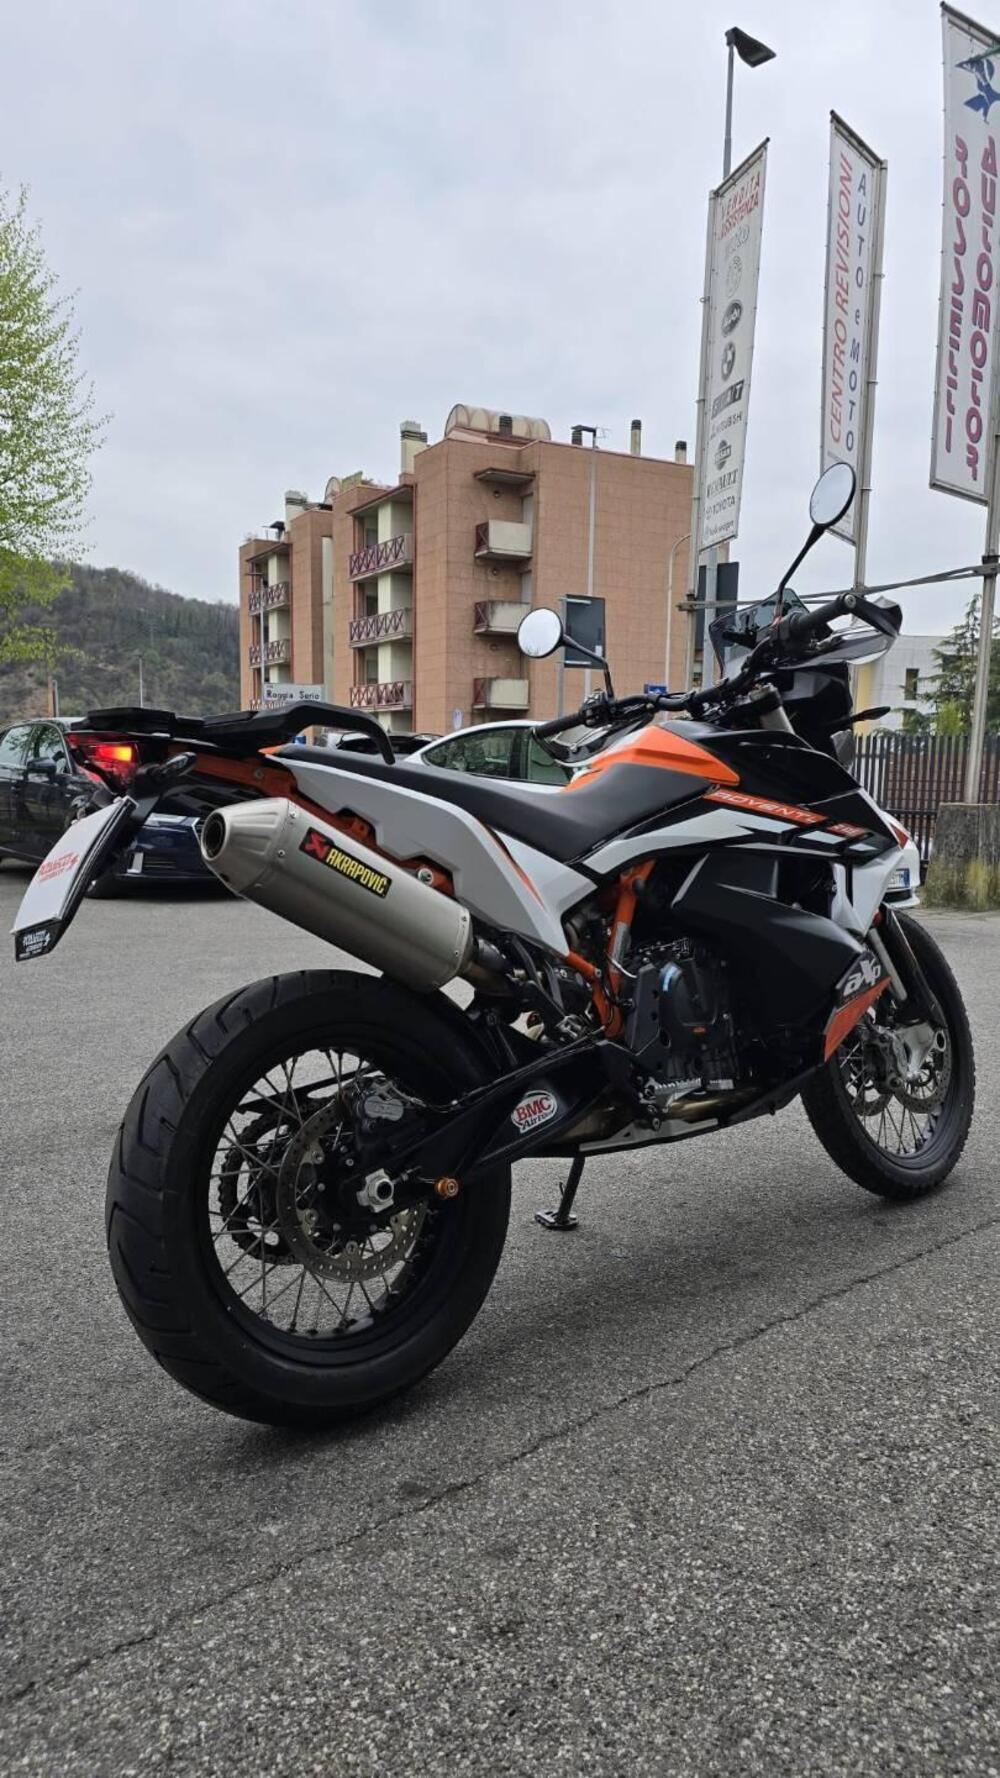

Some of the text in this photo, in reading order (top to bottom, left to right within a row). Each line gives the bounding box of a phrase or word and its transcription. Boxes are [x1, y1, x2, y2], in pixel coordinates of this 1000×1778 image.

[835, 152, 853, 315] REVISIONI
[855, 172, 866, 289] AUTO
[830, 318, 847, 443] CENTRO
[846, 338, 860, 452] MOTO
[516, 1096, 552, 1122] BMC
